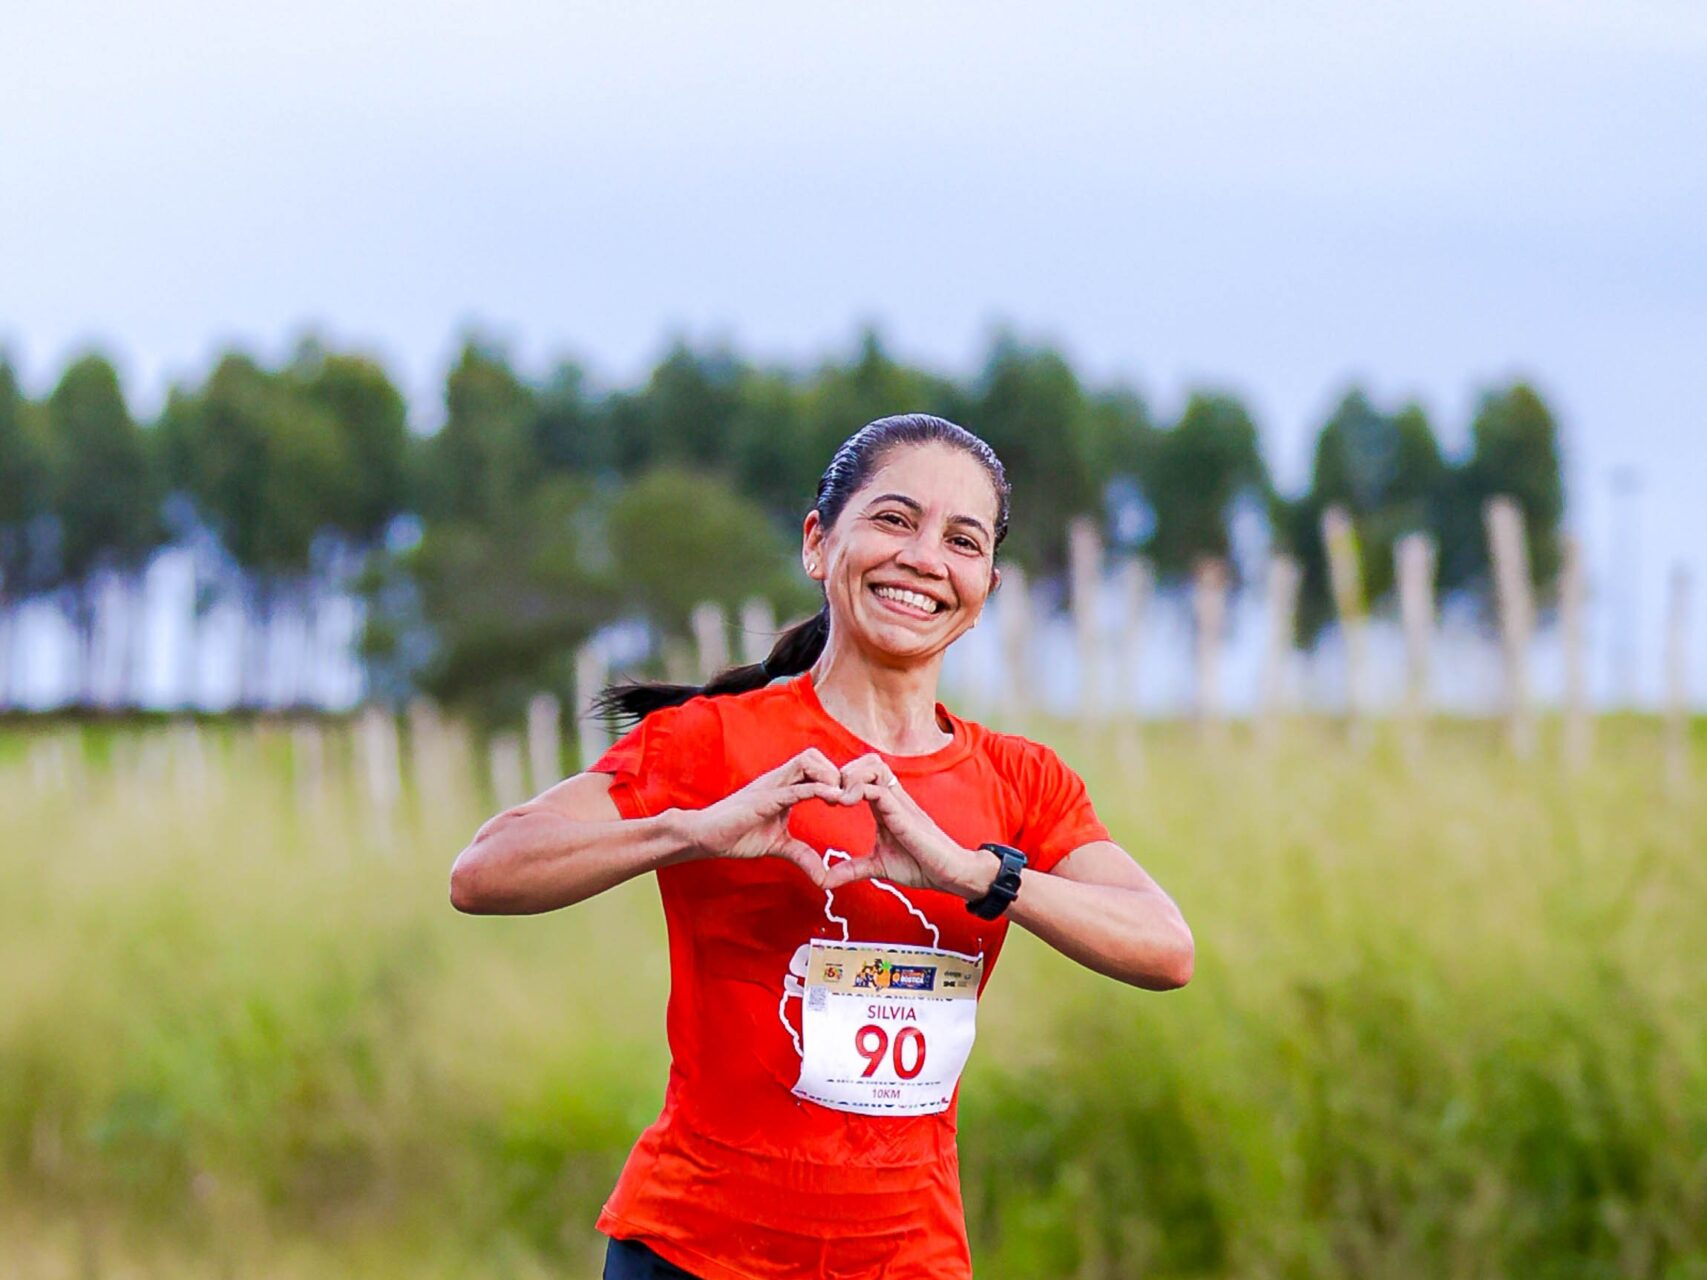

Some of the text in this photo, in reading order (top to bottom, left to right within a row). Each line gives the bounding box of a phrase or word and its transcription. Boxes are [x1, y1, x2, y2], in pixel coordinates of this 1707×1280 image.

[867, 1005, 917, 1021] SILVIA
[855, 1024, 926, 1080] 90
[872, 1089, 901, 1099] 10KM
